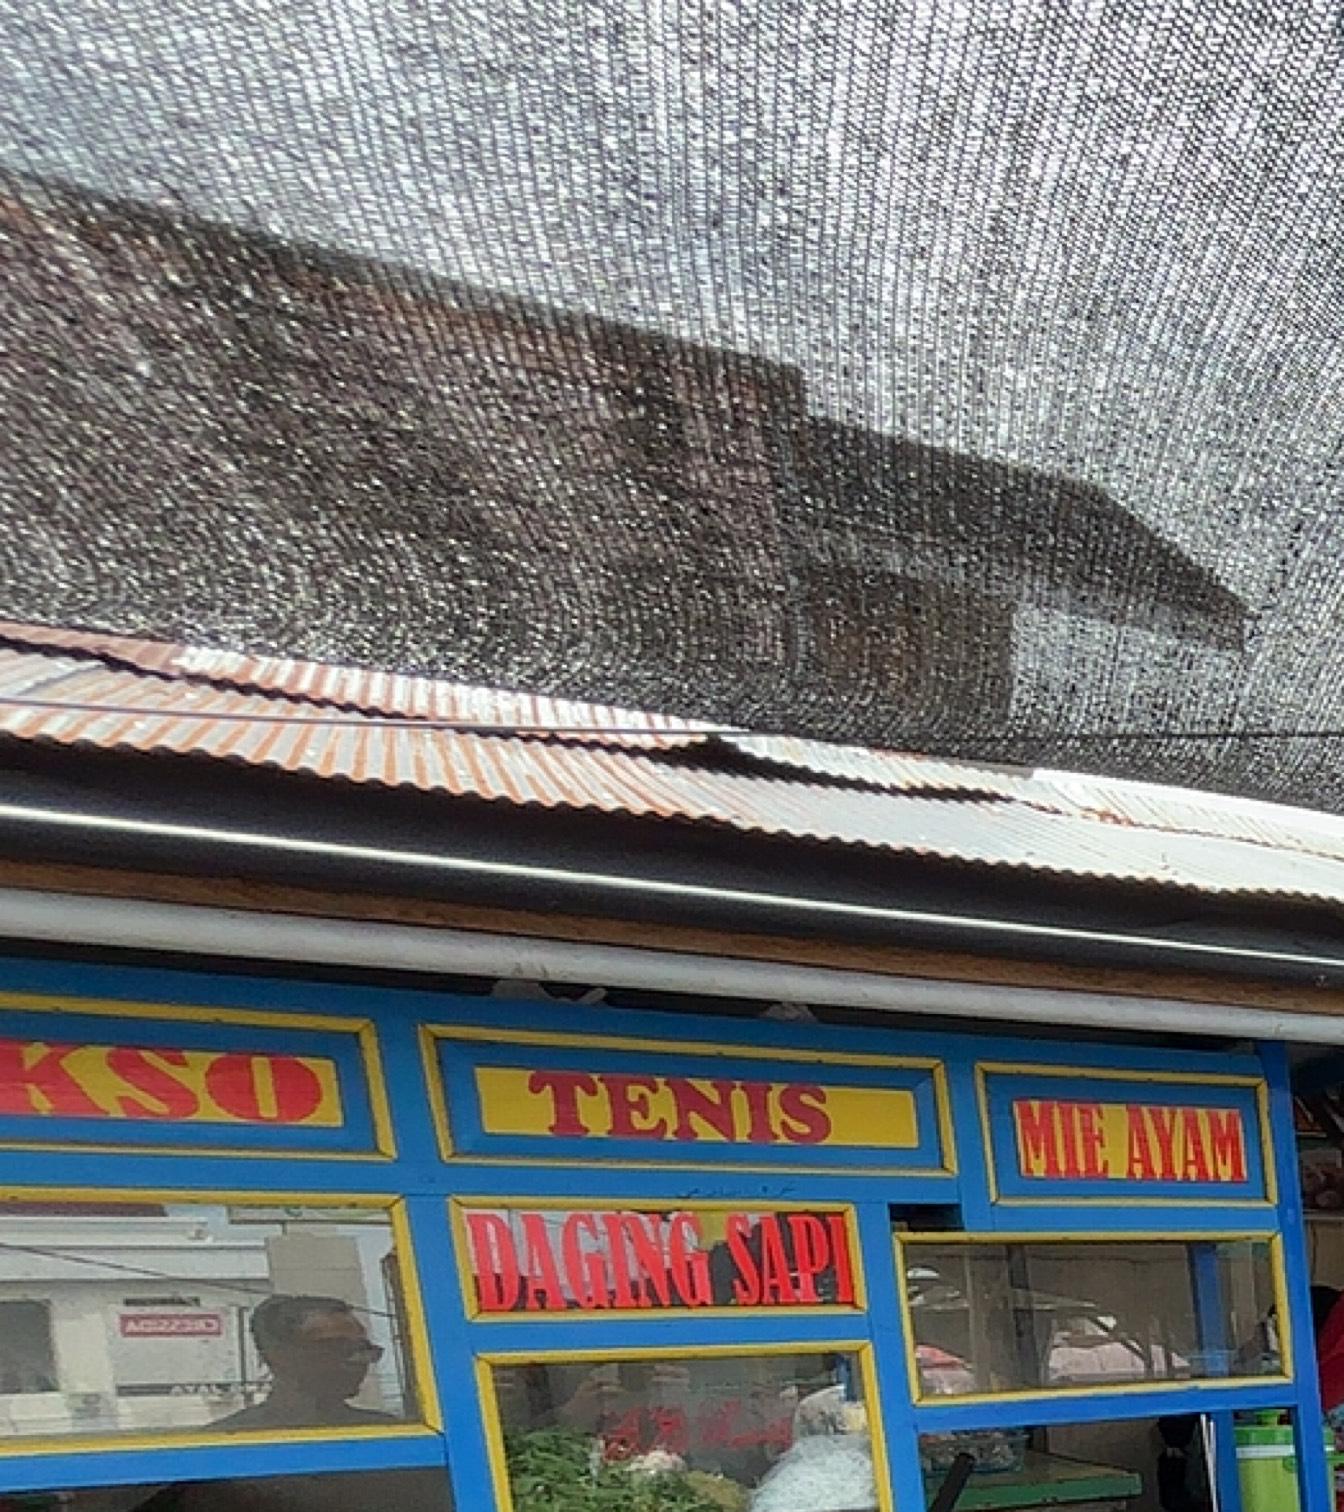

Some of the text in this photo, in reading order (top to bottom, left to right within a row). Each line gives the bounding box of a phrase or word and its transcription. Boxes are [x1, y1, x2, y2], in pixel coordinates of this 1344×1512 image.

[528, 1070, 832, 1143] TENIS
[1016, 1101, 1109, 1176] MIE
[1127, 1106, 1247, 1181] AYAM
[467, 1211, 856, 1313] DAGING SAPI
